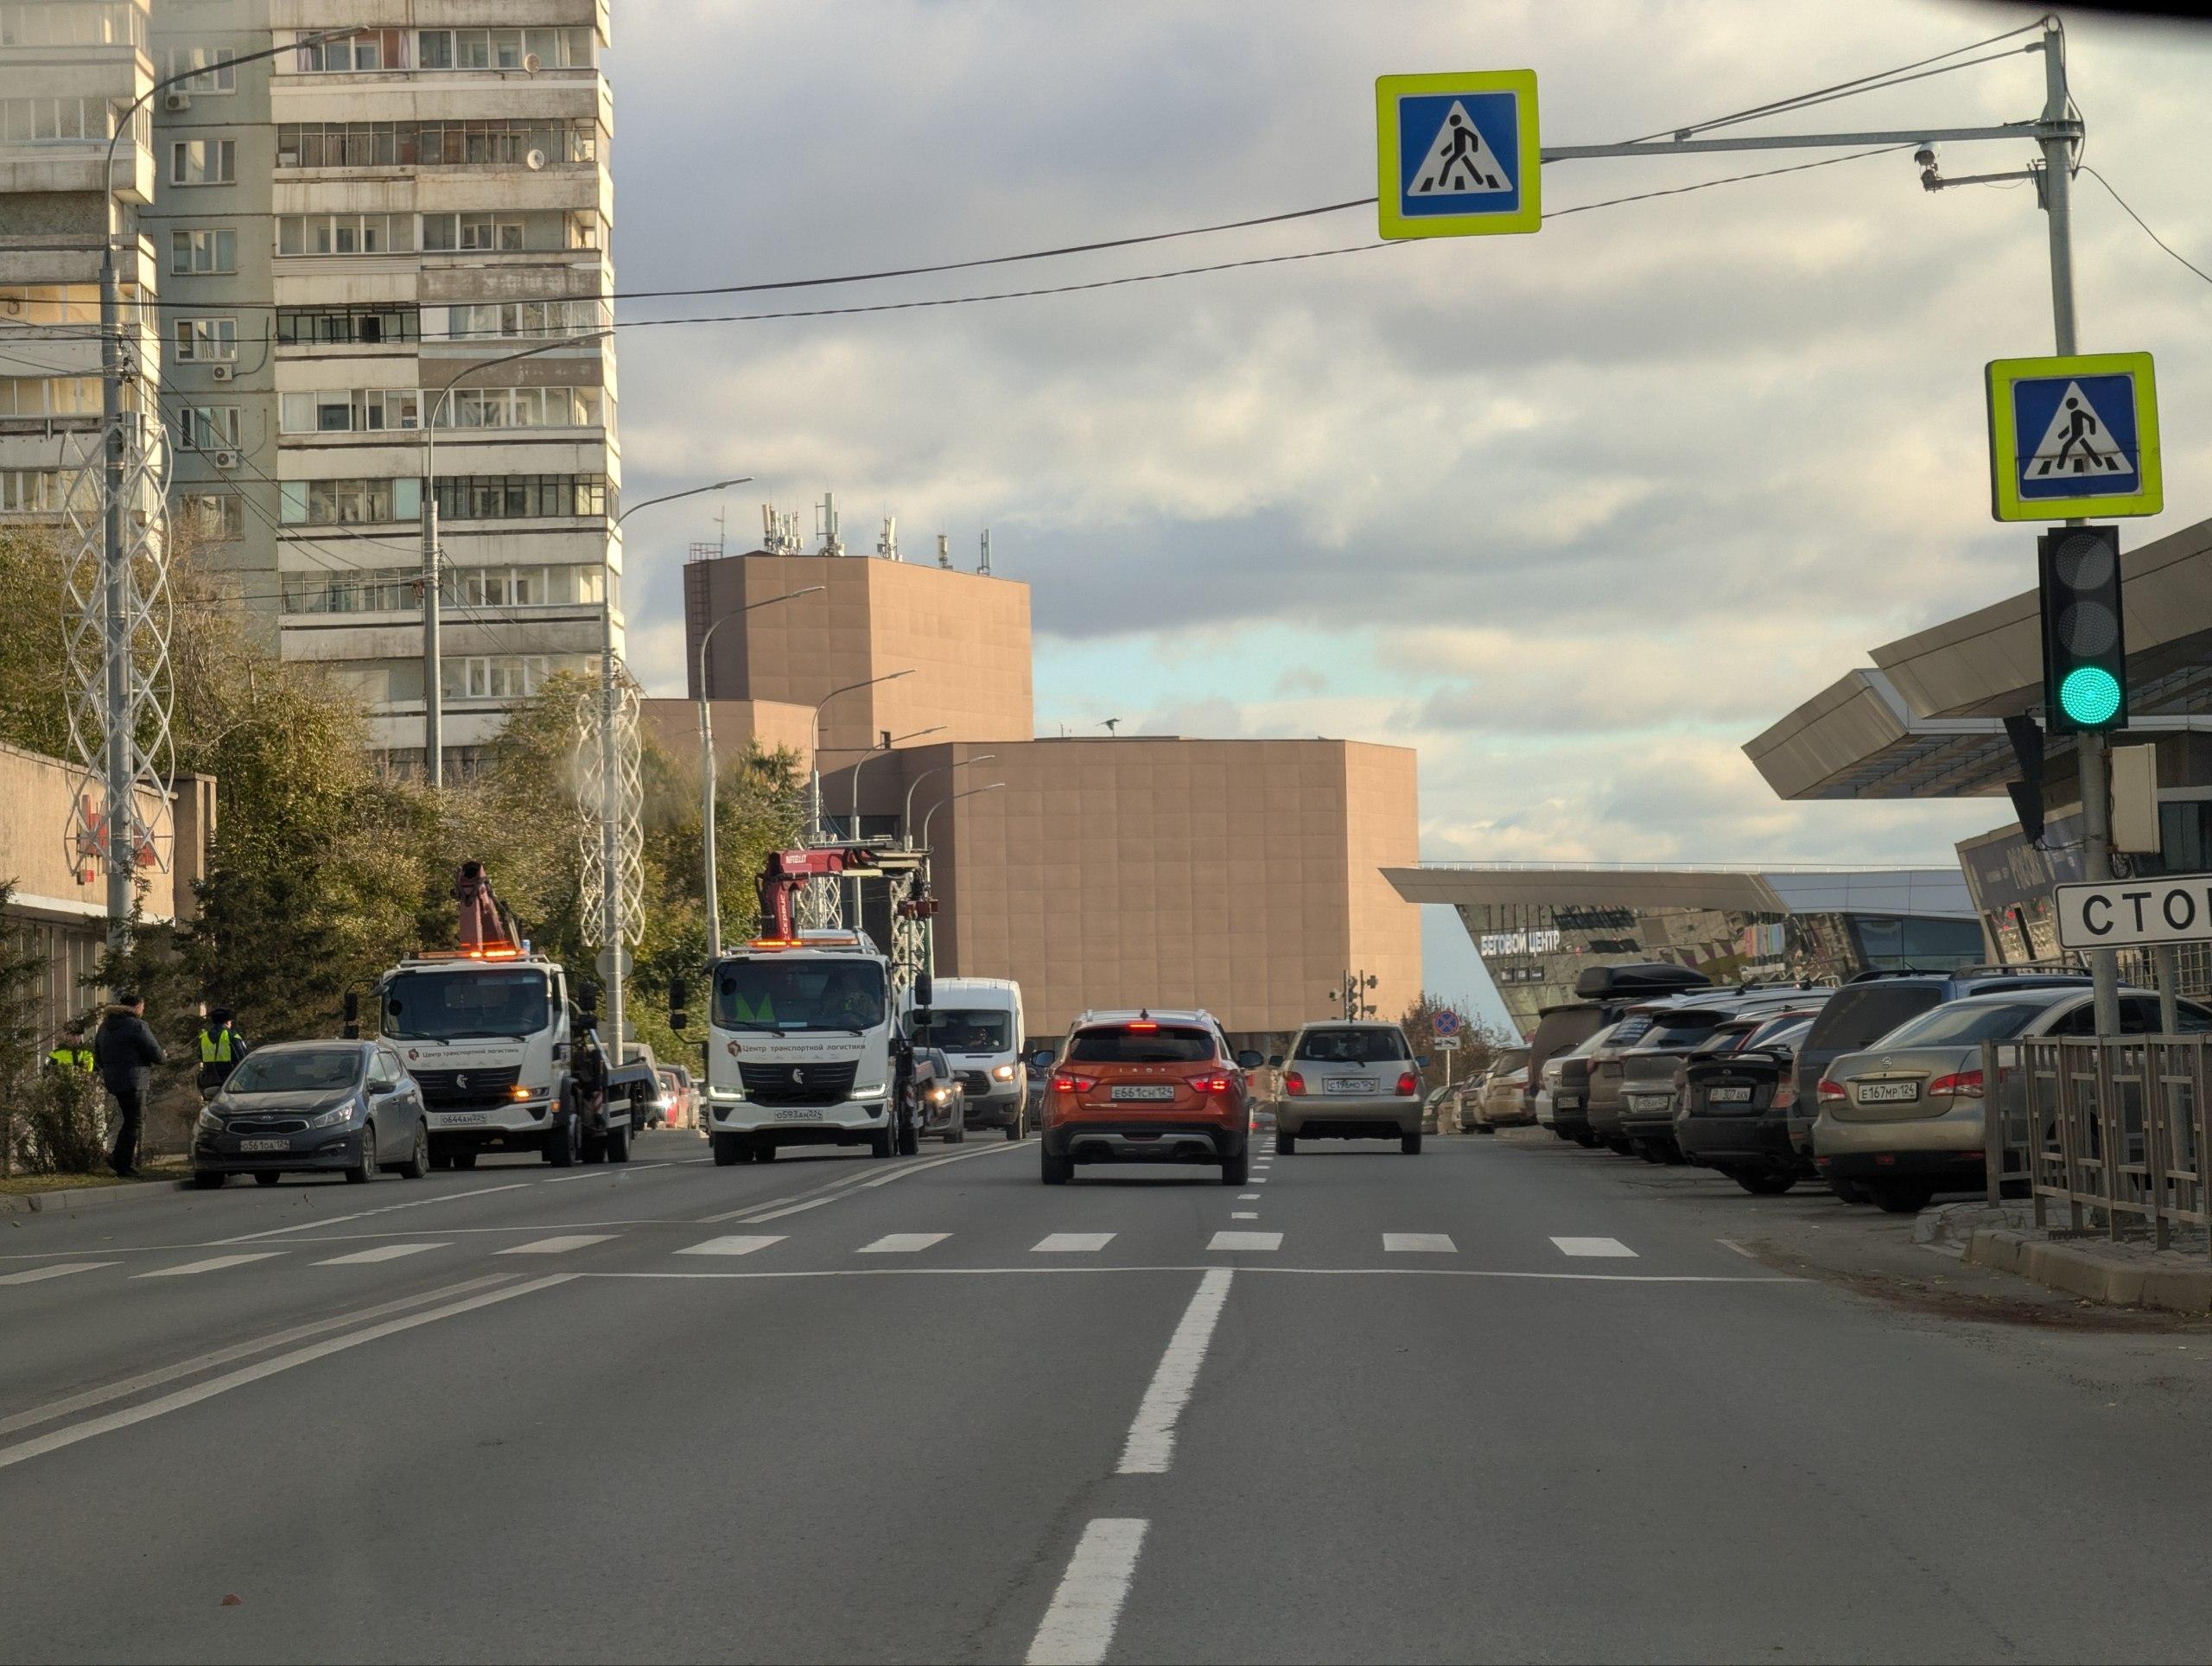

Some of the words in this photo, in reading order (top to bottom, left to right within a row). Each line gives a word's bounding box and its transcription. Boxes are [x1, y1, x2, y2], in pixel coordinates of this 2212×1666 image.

[2082, 887, 2212, 936] СТО
[1481, 927, 1527, 957] БЕГОВОЙ
[1529, 930, 1560, 957] ЦЕНТР
[742, 1044, 766, 1052] Центр
[771, 1044, 823, 1052] транспортной
